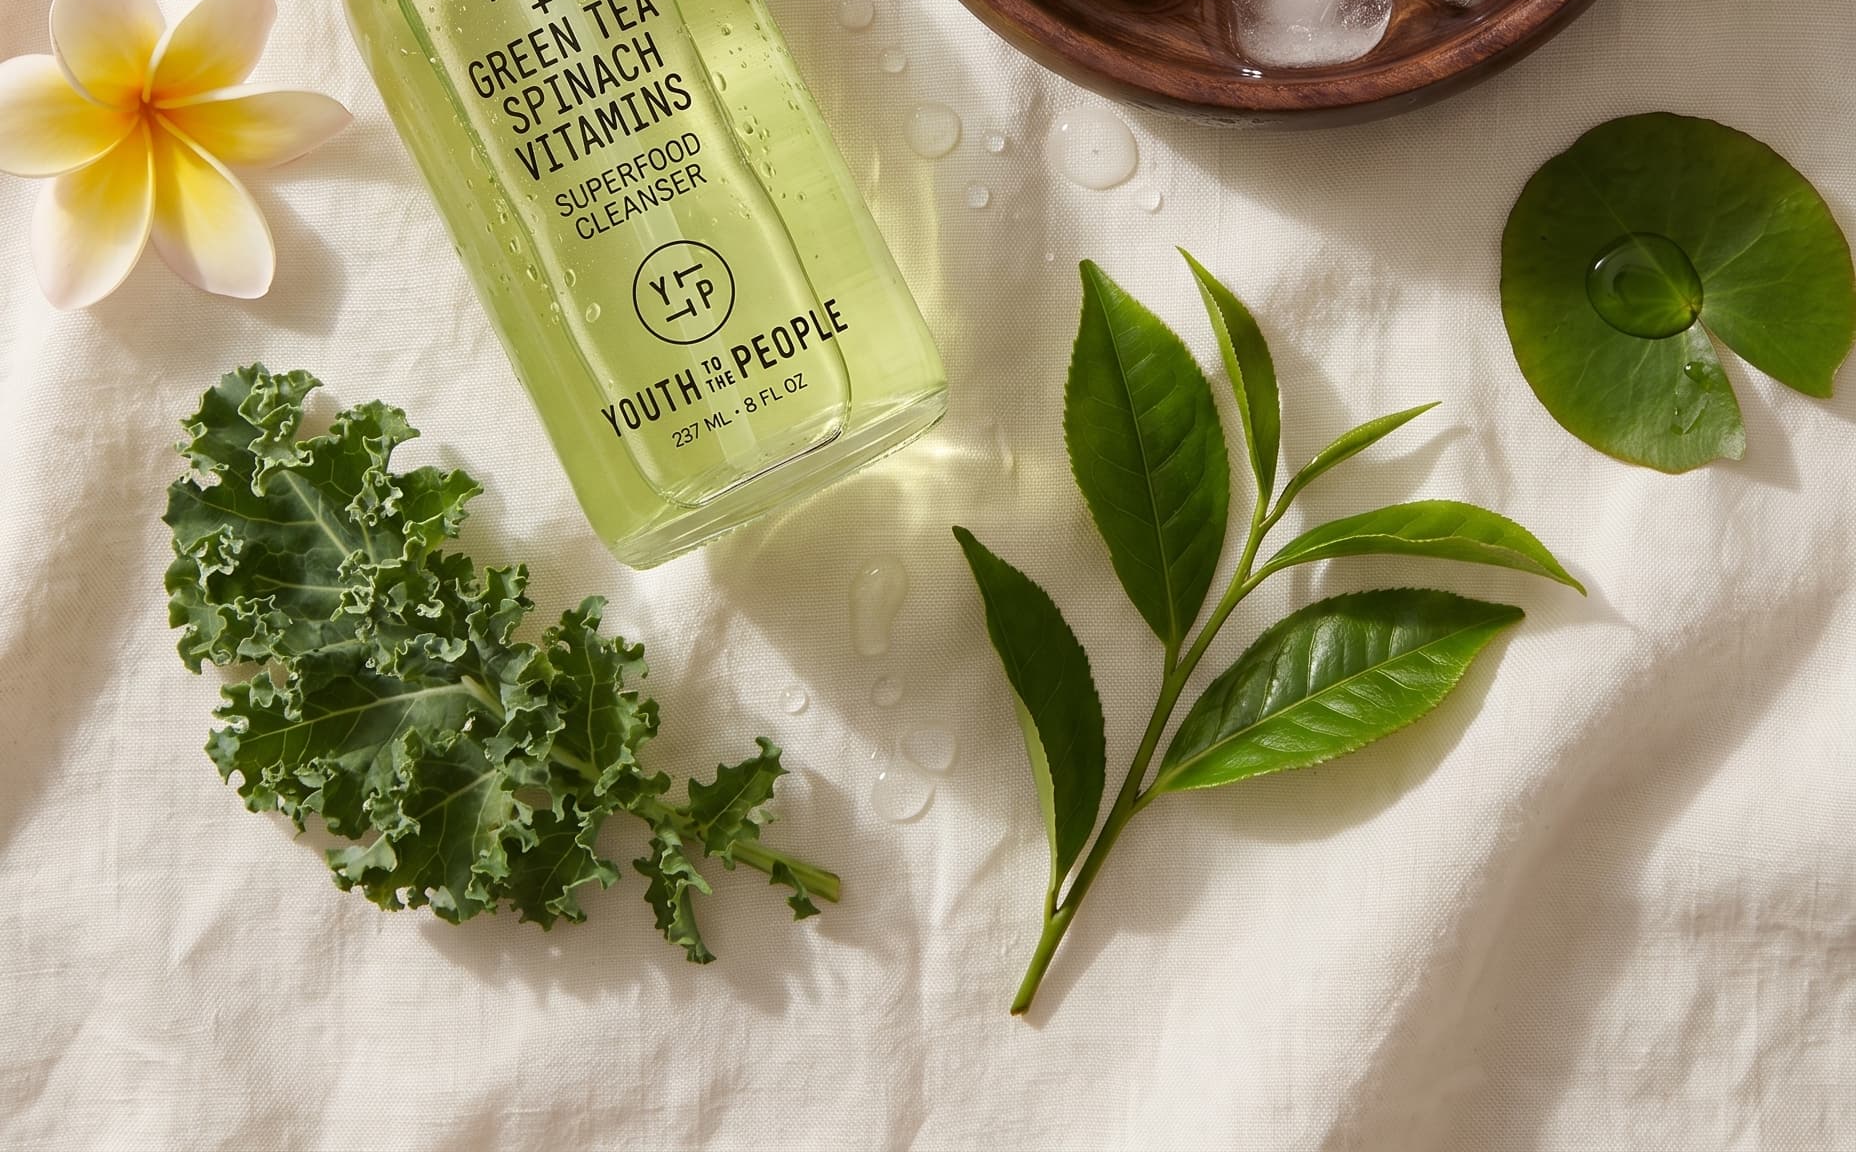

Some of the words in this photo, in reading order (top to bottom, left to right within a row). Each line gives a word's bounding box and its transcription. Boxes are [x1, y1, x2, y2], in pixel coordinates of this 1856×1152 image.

[468, 16, 582, 99] GREEN
[503, 31, 664, 135] SPINACH
[514, 73, 692, 181] VITAMINS
[555, 132, 701, 217] SUPERFOOD
[575, 163, 707, 240] CLEANSER
[700, 356, 723, 375] TO
[730, 298, 849, 379] PEOPLE
[600, 368, 703, 438] YOUTH
[671, 422, 700, 449] 237
[703, 410, 733, 433] ML
[743, 396, 758, 414] 8
[758, 386, 784, 407] FL
[783, 372, 809, 394] OZ
[705, 370, 736, 394] THE
